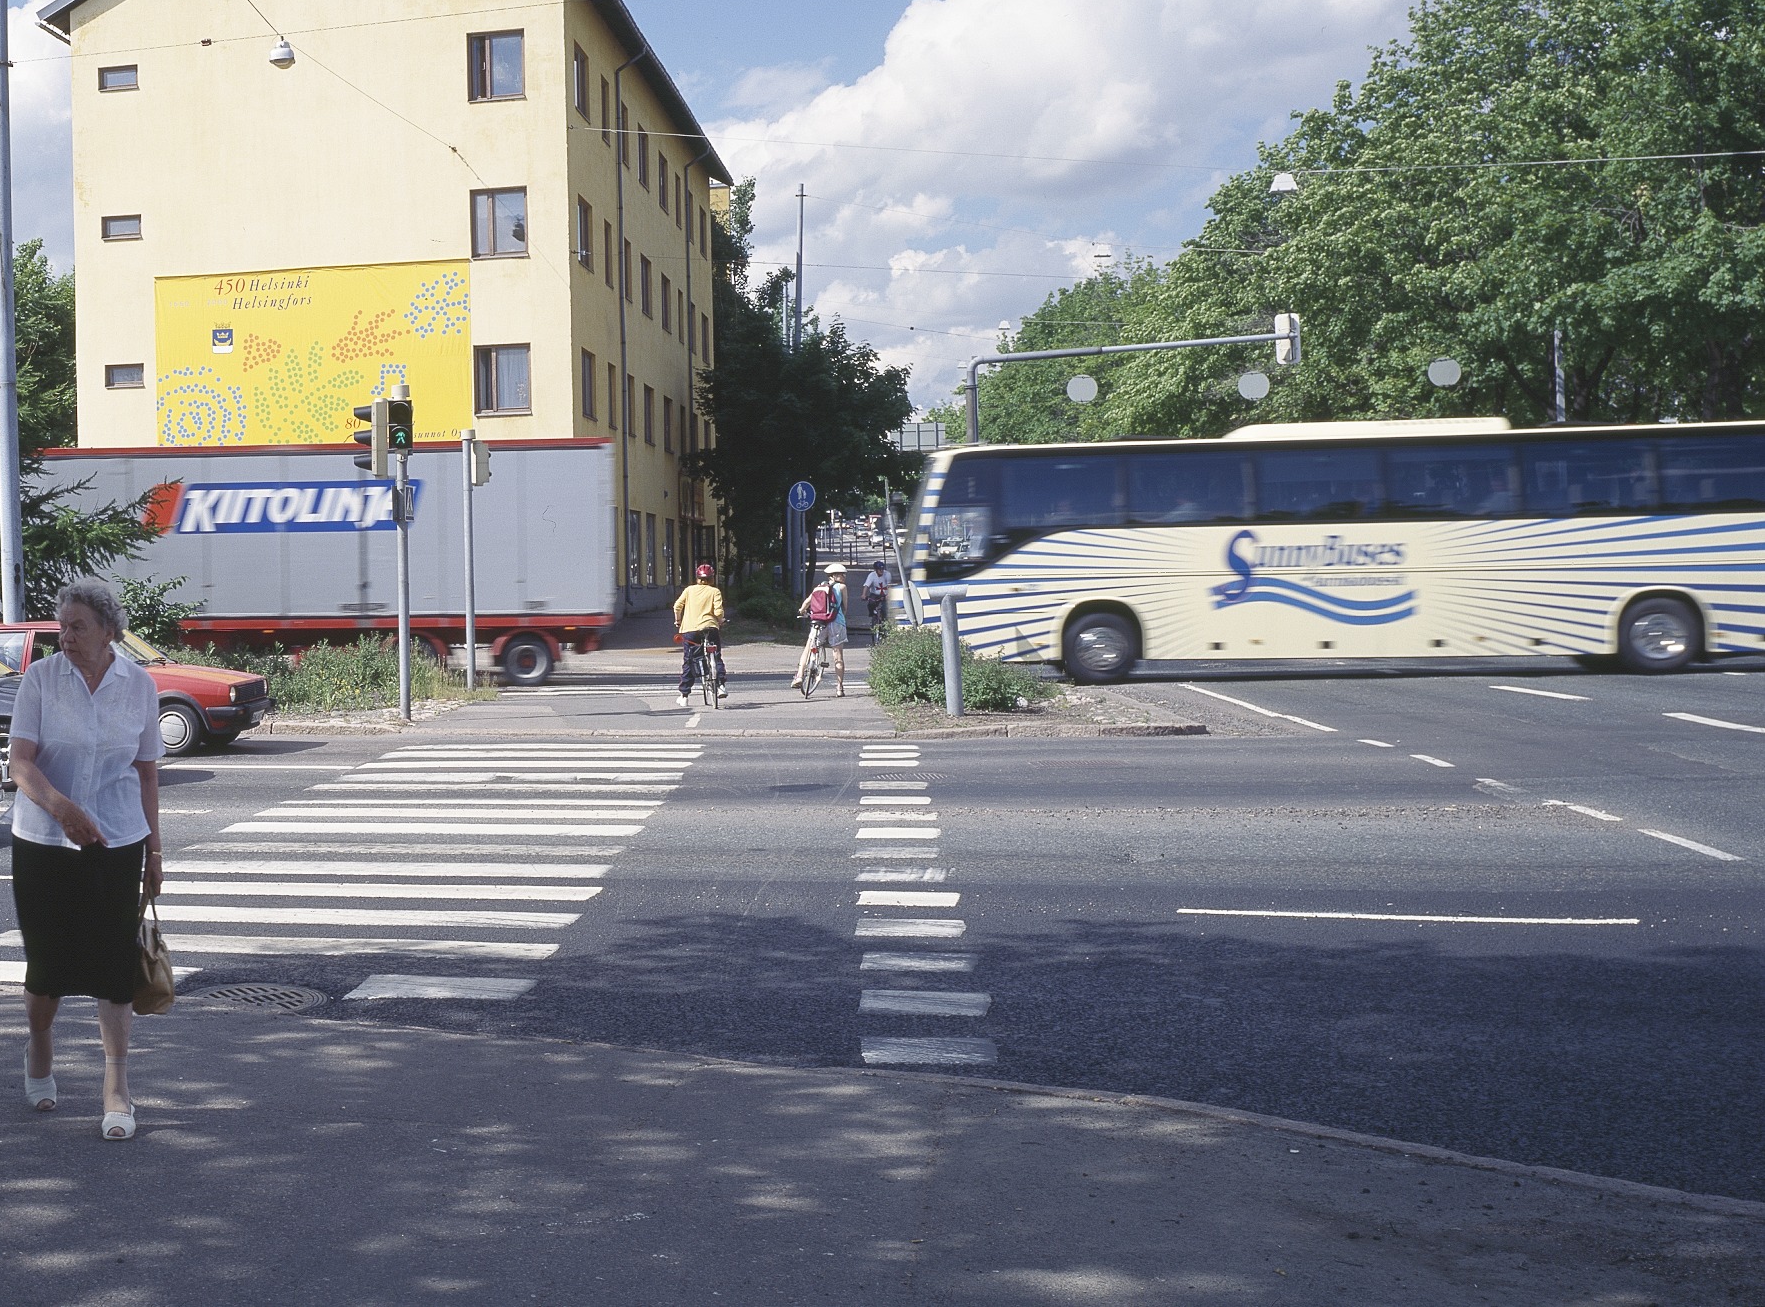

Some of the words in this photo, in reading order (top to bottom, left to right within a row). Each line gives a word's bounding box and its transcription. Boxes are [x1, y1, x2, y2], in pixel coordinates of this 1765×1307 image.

[213, 277, 246, 296] 450
[249, 275, 310, 292] Helsinki
[232, 293, 312, 311] Helsingfors
[413, 429, 446, 440] sunnot
